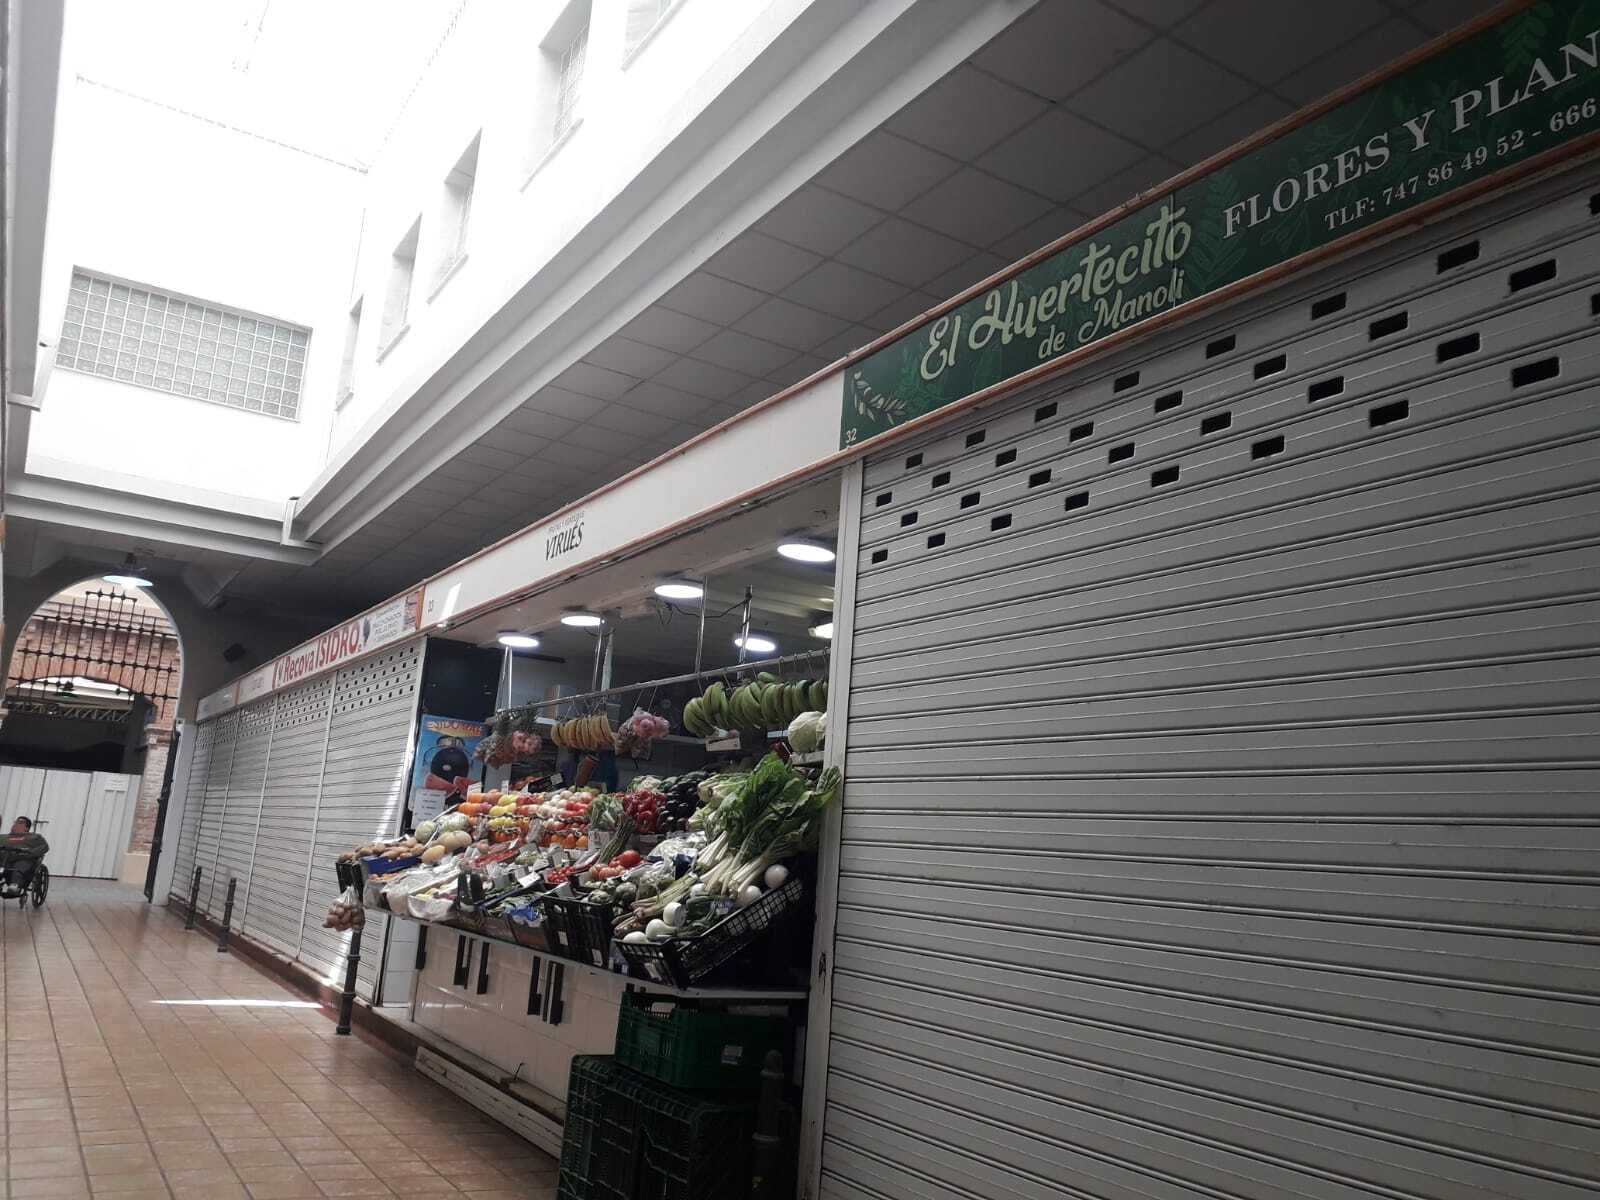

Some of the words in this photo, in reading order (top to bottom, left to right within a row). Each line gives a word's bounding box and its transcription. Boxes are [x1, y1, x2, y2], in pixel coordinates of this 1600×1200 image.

[1223, 131, 1391, 239] FLORES
[1402, 108, 1436, 152] Y
[1451, 30, 1600, 134] PLAN
[1325, 196, 1375, 231] TLF:
[1383, 175, 1419, 207] 747
[1427, 160, 1453, 188] 86
[1460, 145, 1488, 172] 49
[1496, 129, 1526, 156] 52
[1550, 97, 1597, 133] 666
[920, 315, 962, 381] El
[968, 205, 1192, 350] Huertecito
[1037, 325, 1066, 360] de
[1078, 267, 1185, 344] Manoli
[545, 520, 585, 561] VIRUÉS
[283, 650, 316, 684] Recova
